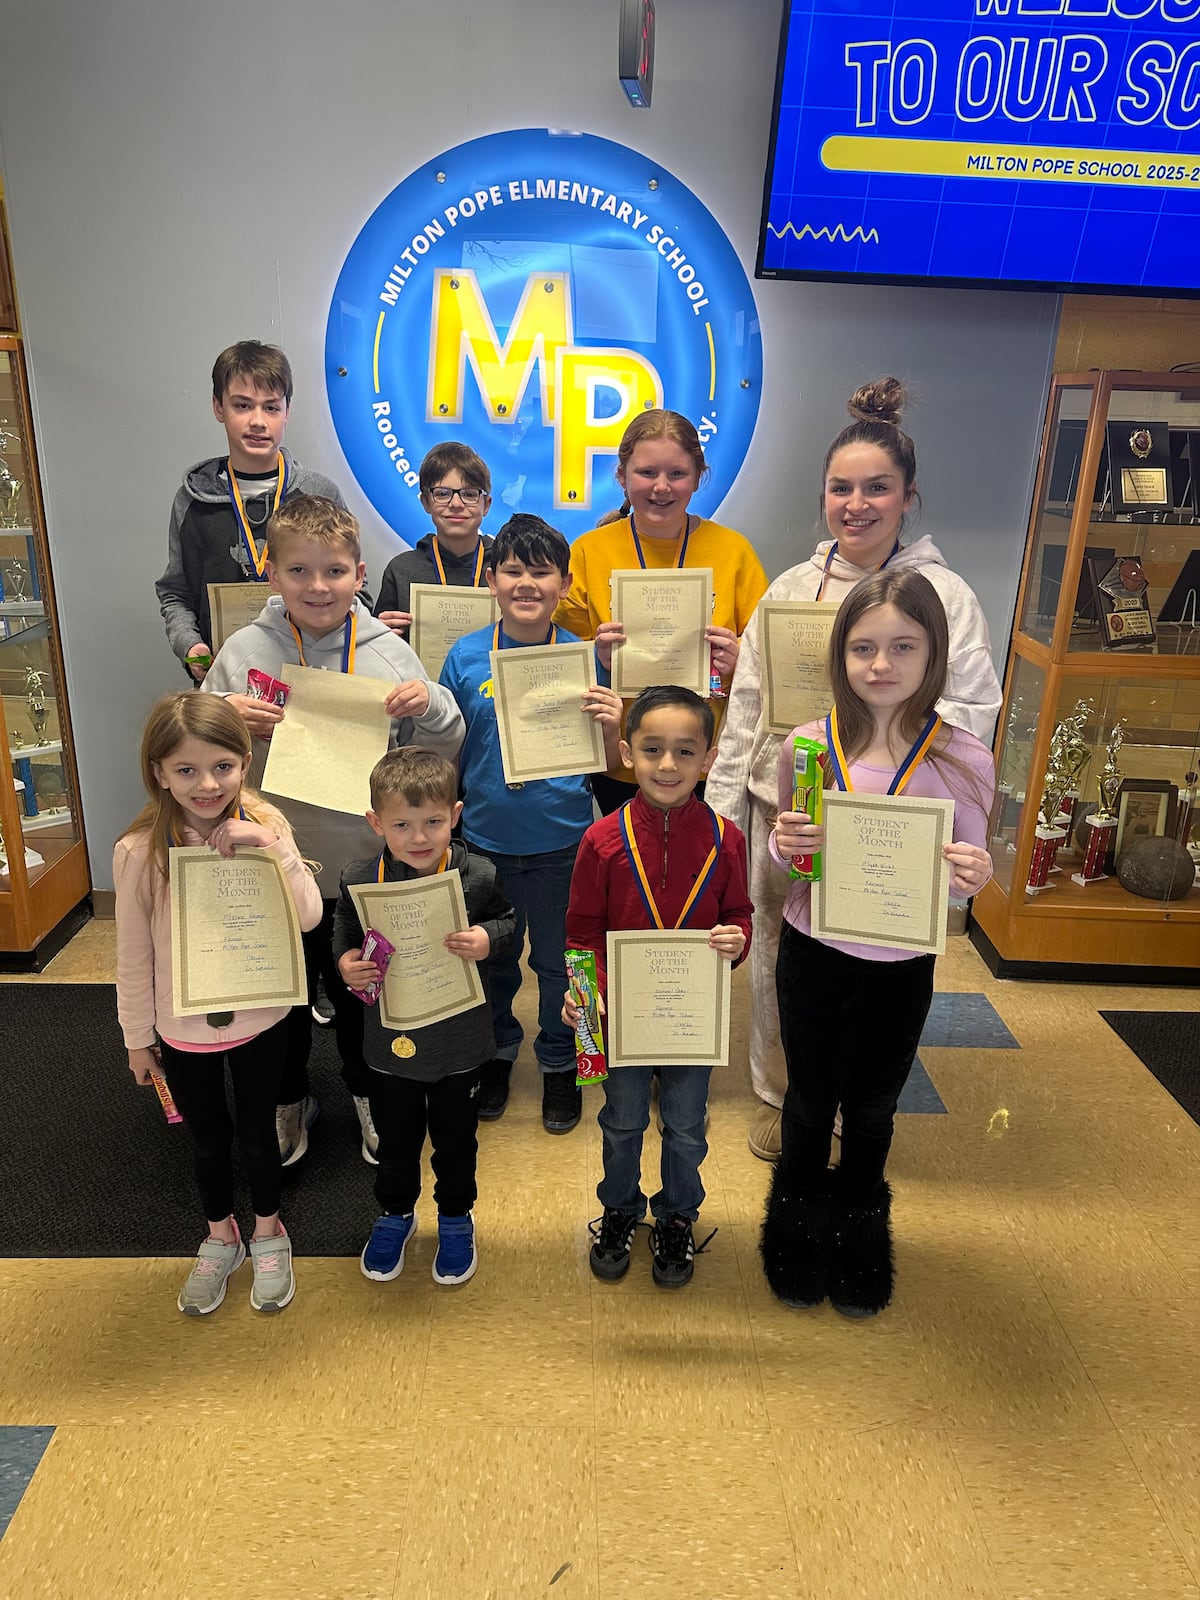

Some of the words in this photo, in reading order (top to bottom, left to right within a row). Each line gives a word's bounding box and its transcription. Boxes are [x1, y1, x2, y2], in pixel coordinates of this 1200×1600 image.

[845, 39, 937, 128] TO
[955, 35, 1108, 123] OUR
[967, 155, 1028, 172] MILTON
[1032, 158, 1075, 174] POPE
[1078, 161, 1142, 178] SCHOOL
[379, 219, 446, 306] MILTON
[444, 185, 503, 227] POPE
[508, 179, 648, 230] ELMENTARY
[646, 225, 709, 315] SCHOOL
[372, 401, 421, 488] Rooted
[642, 586, 682, 596] STUDENT
[660, 595, 678, 603] THE
[438, 601, 475, 610] STUDENT
[645, 603, 680, 612] MONTH
[440, 615, 471, 625] MONTH
[788, 620, 831, 631] STUDENT
[793, 630, 805, 638] OF
[805, 631, 824, 639] THE
[792, 637, 826, 648] MONTH
[523, 663, 565, 674] STUDENT
[529, 673, 542, 681] OF
[543, 671, 560, 679] THE
[528, 680, 562, 690] MONTH
[853, 814, 910, 830] STUDENT
[860, 826, 877, 835] OF
[877, 828, 902, 839] THE
[857, 834, 904, 849] MONTH
[212, 867, 262, 878] STUDENT
[219, 878, 233, 887] OF
[235, 877, 258, 886] THE
[217, 887, 261, 898] MONTH
[383, 900, 428, 913] STUDENT
[390, 913, 401, 921] OF
[402, 910, 424, 920] THE
[390, 919, 429, 931] MONTH
[644, 948, 694, 958] STUDENT
[666, 958, 688, 966] THE
[649, 966, 690, 975] MONTH
